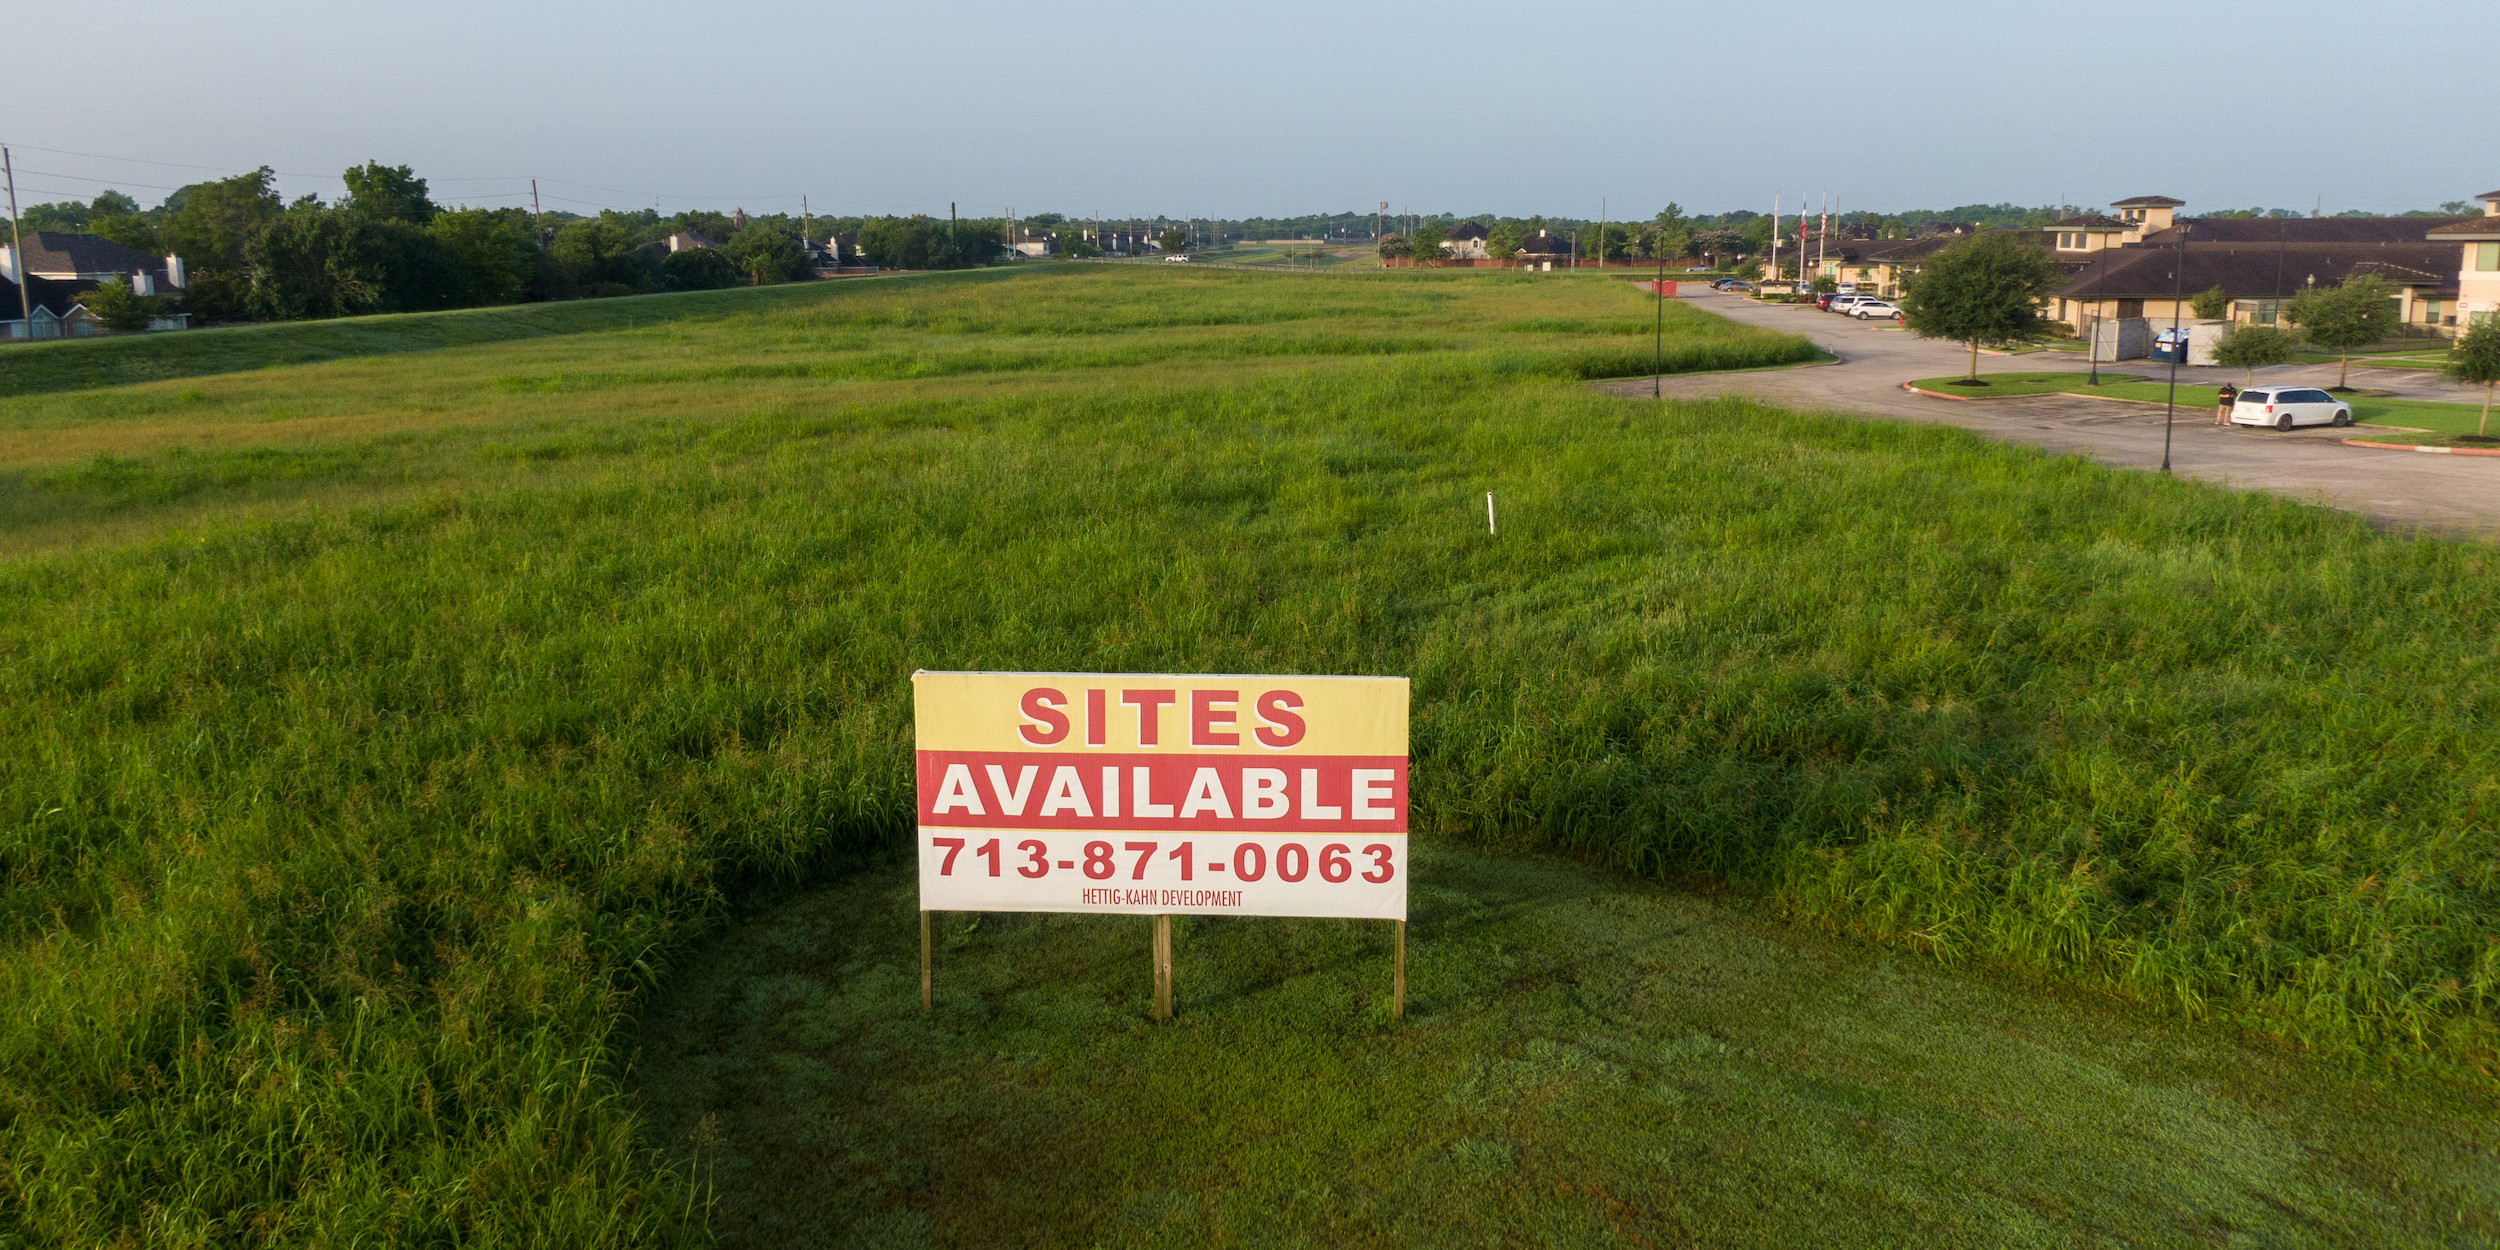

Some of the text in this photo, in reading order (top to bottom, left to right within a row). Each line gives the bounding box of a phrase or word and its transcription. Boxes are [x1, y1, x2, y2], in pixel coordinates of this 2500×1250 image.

[1017, 688, 1306, 750] SITES
[932, 763, 1396, 820] AVAILABLE
[932, 837, 1395, 883] 713-871-0063
[1082, 888, 1243, 907] HETTIG-KAHN DEVELOPMENT
